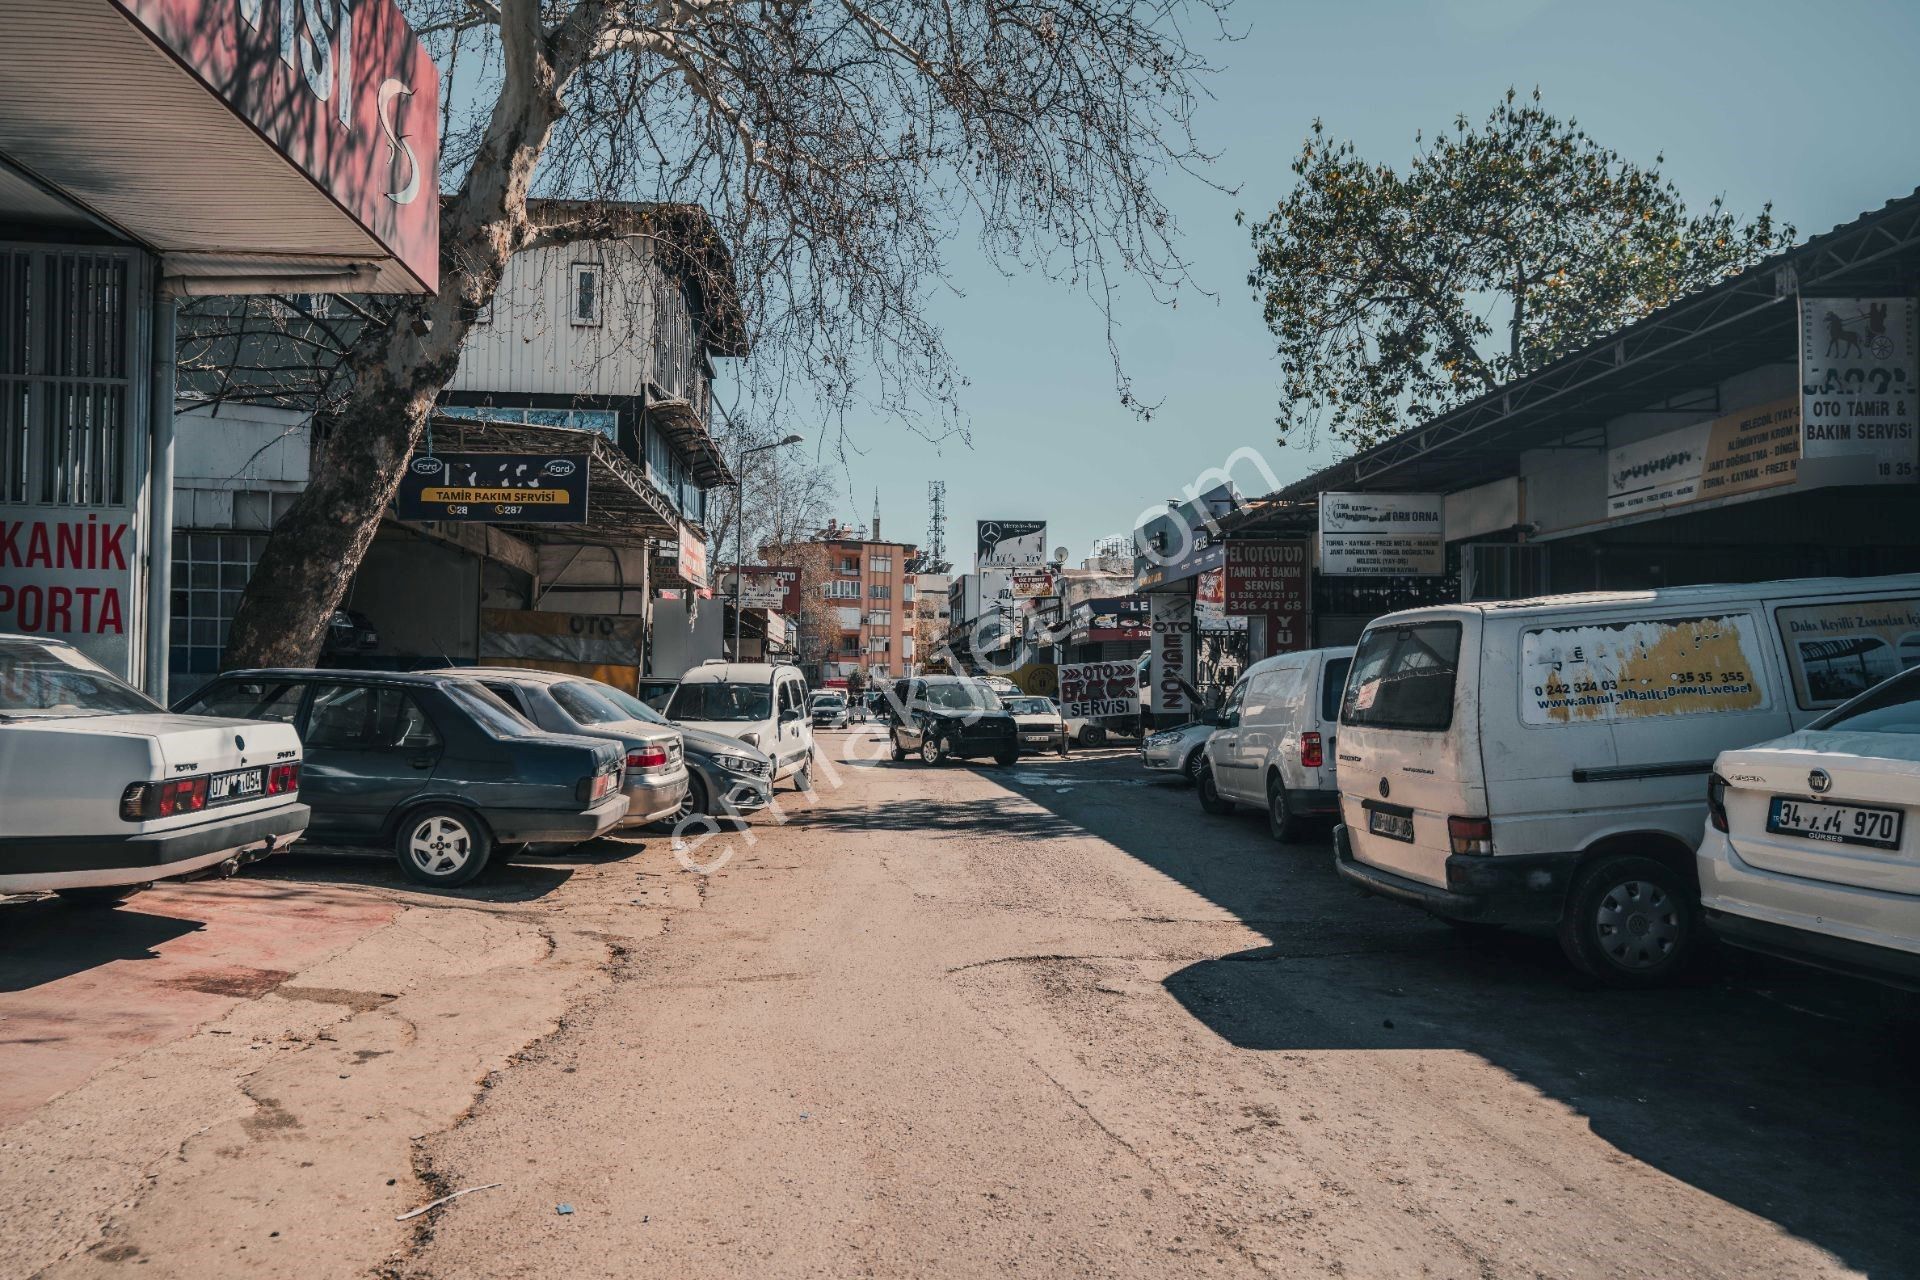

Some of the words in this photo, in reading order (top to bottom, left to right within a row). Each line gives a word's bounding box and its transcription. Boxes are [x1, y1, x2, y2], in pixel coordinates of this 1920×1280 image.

[1813, 401, 1840, 417] OTO
[1896, 401, 1906, 416] &
[1807, 424, 1850, 440] BAKIM
[436, 489, 471, 501] TAMİR
[505, 506, 523, 515] 287
[1273, 567, 1300, 578] BAKIM
[1230, 601, 1257, 610] 346
[1261, 601, 1279, 610] 41
[1284, 601, 1302, 610] 68
[570, 616, 614, 635] OTO
[1152, 621, 1191, 634] OTO
[1083, 664, 1114, 680] OTO
[1535, 687, 1543, 697] 0
[1546, 682, 1571, 695] 242
[1574, 681, 1598, 692] 324
[1601, 679, 1618, 691] 03
[1721, 671, 1745, 683] 355
[1780, 803, 1801, 827] 34
[1854, 811, 1894, 839] 970
[1809, 832, 1844, 843] GÜRSES
